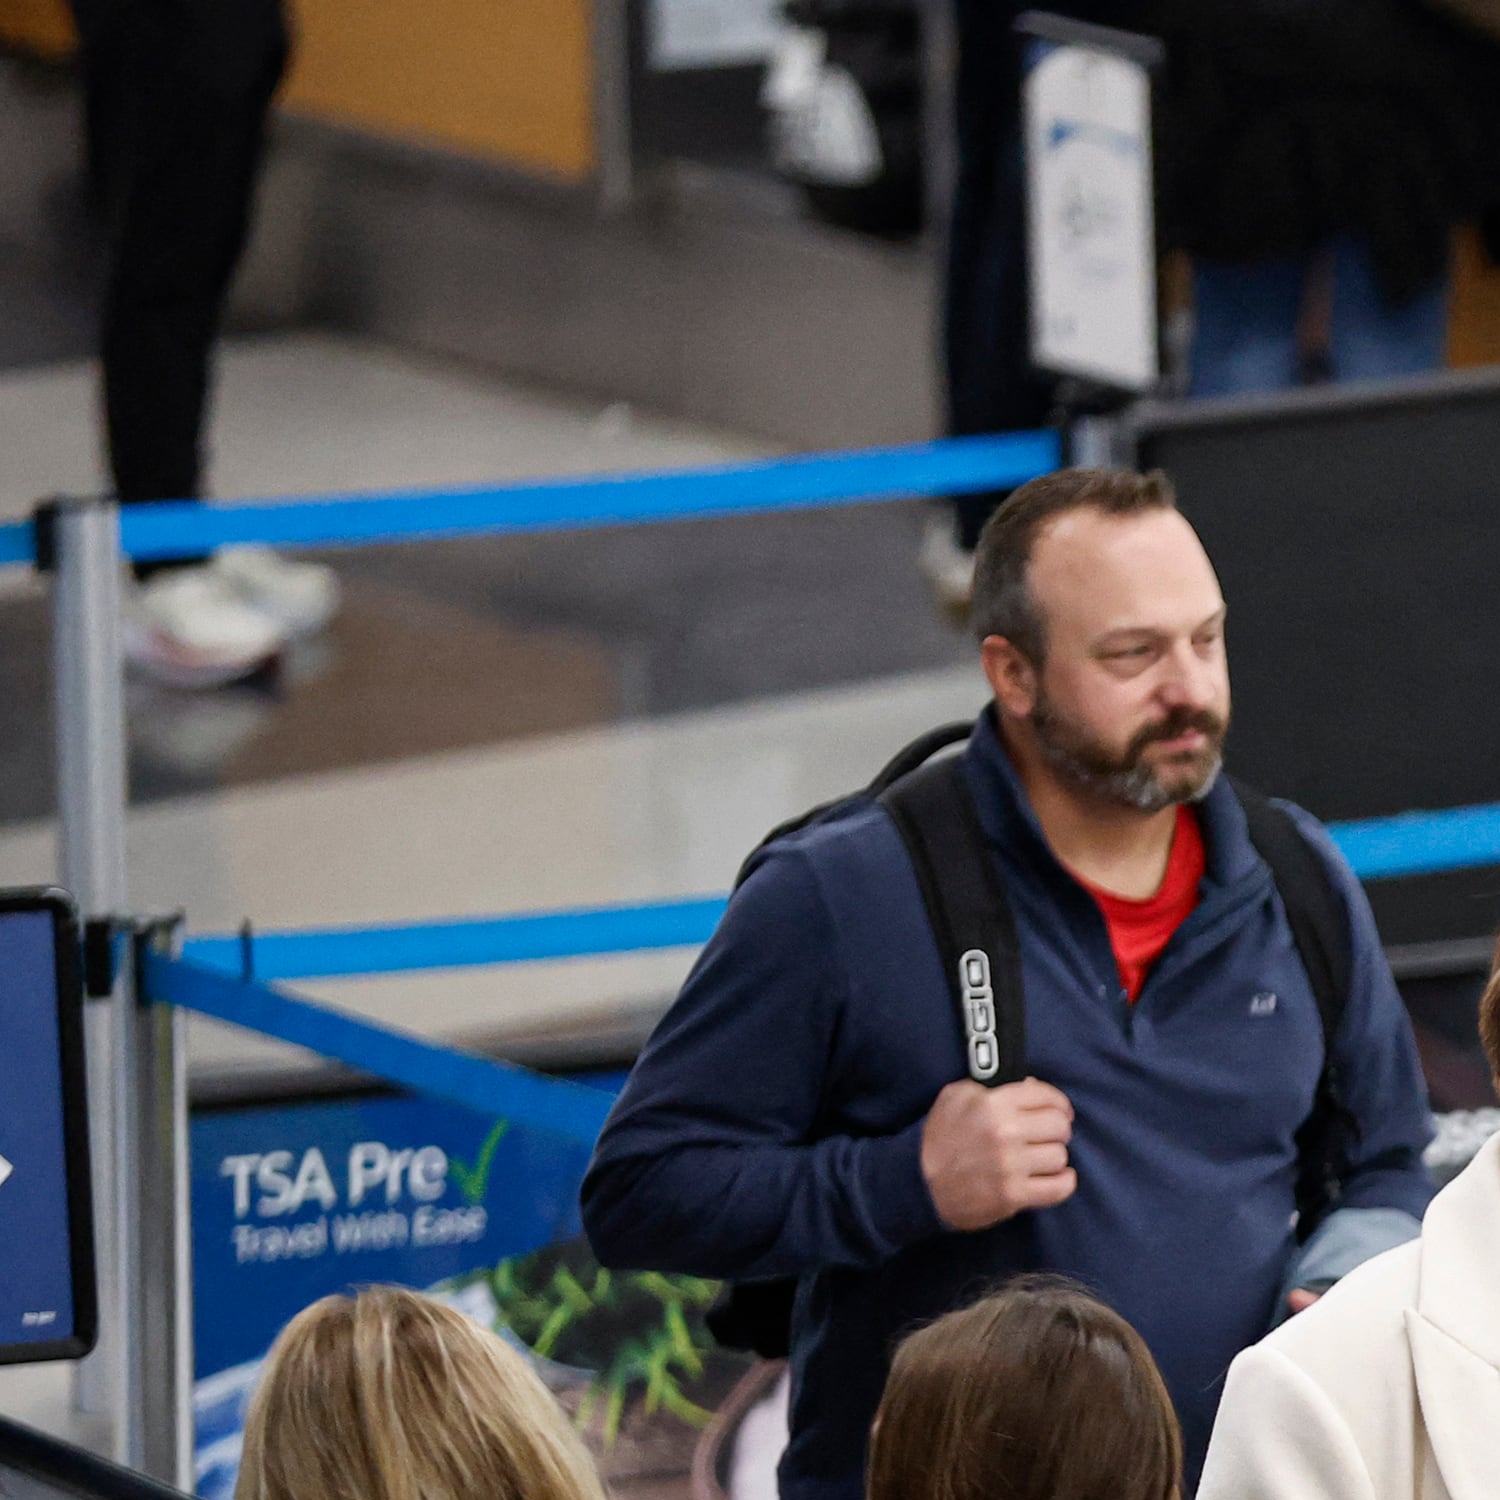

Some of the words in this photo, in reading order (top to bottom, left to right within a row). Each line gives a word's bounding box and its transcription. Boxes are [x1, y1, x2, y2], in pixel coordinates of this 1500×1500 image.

[959, 948, 999, 1080] OGIO
[221, 1147, 338, 1218] TSA
[349, 1141, 448, 1204] Pre
[232, 1214, 328, 1264] Travel
[331, 1208, 409, 1252] With
[411, 1204, 488, 1248] Ease
